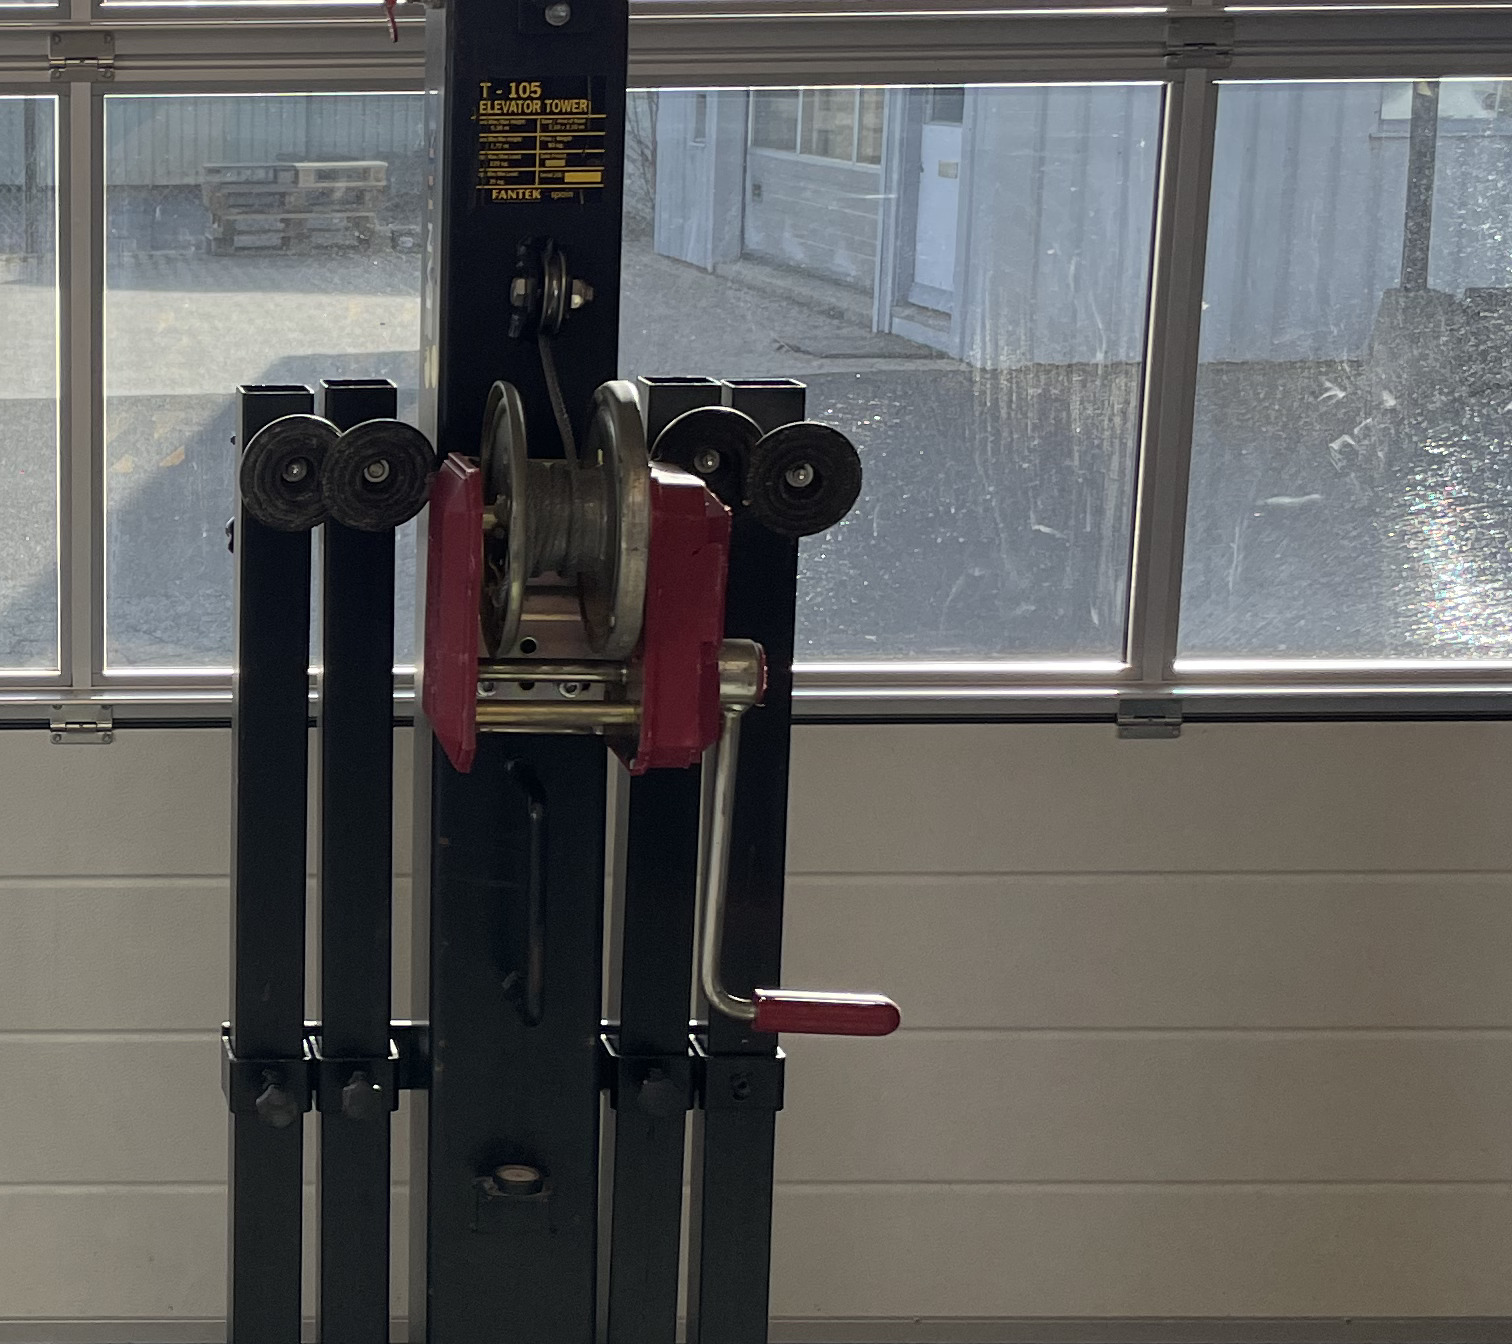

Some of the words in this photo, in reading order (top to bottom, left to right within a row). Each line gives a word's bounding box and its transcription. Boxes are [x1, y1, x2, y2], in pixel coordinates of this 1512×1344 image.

[479, 82, 492, 98] T
[508, 81, 543, 98] 105
[479, 99, 541, 114] ELEVATOR
[544, 99, 588, 113] TOWER
[491, 189, 542, 201] FANTEK
